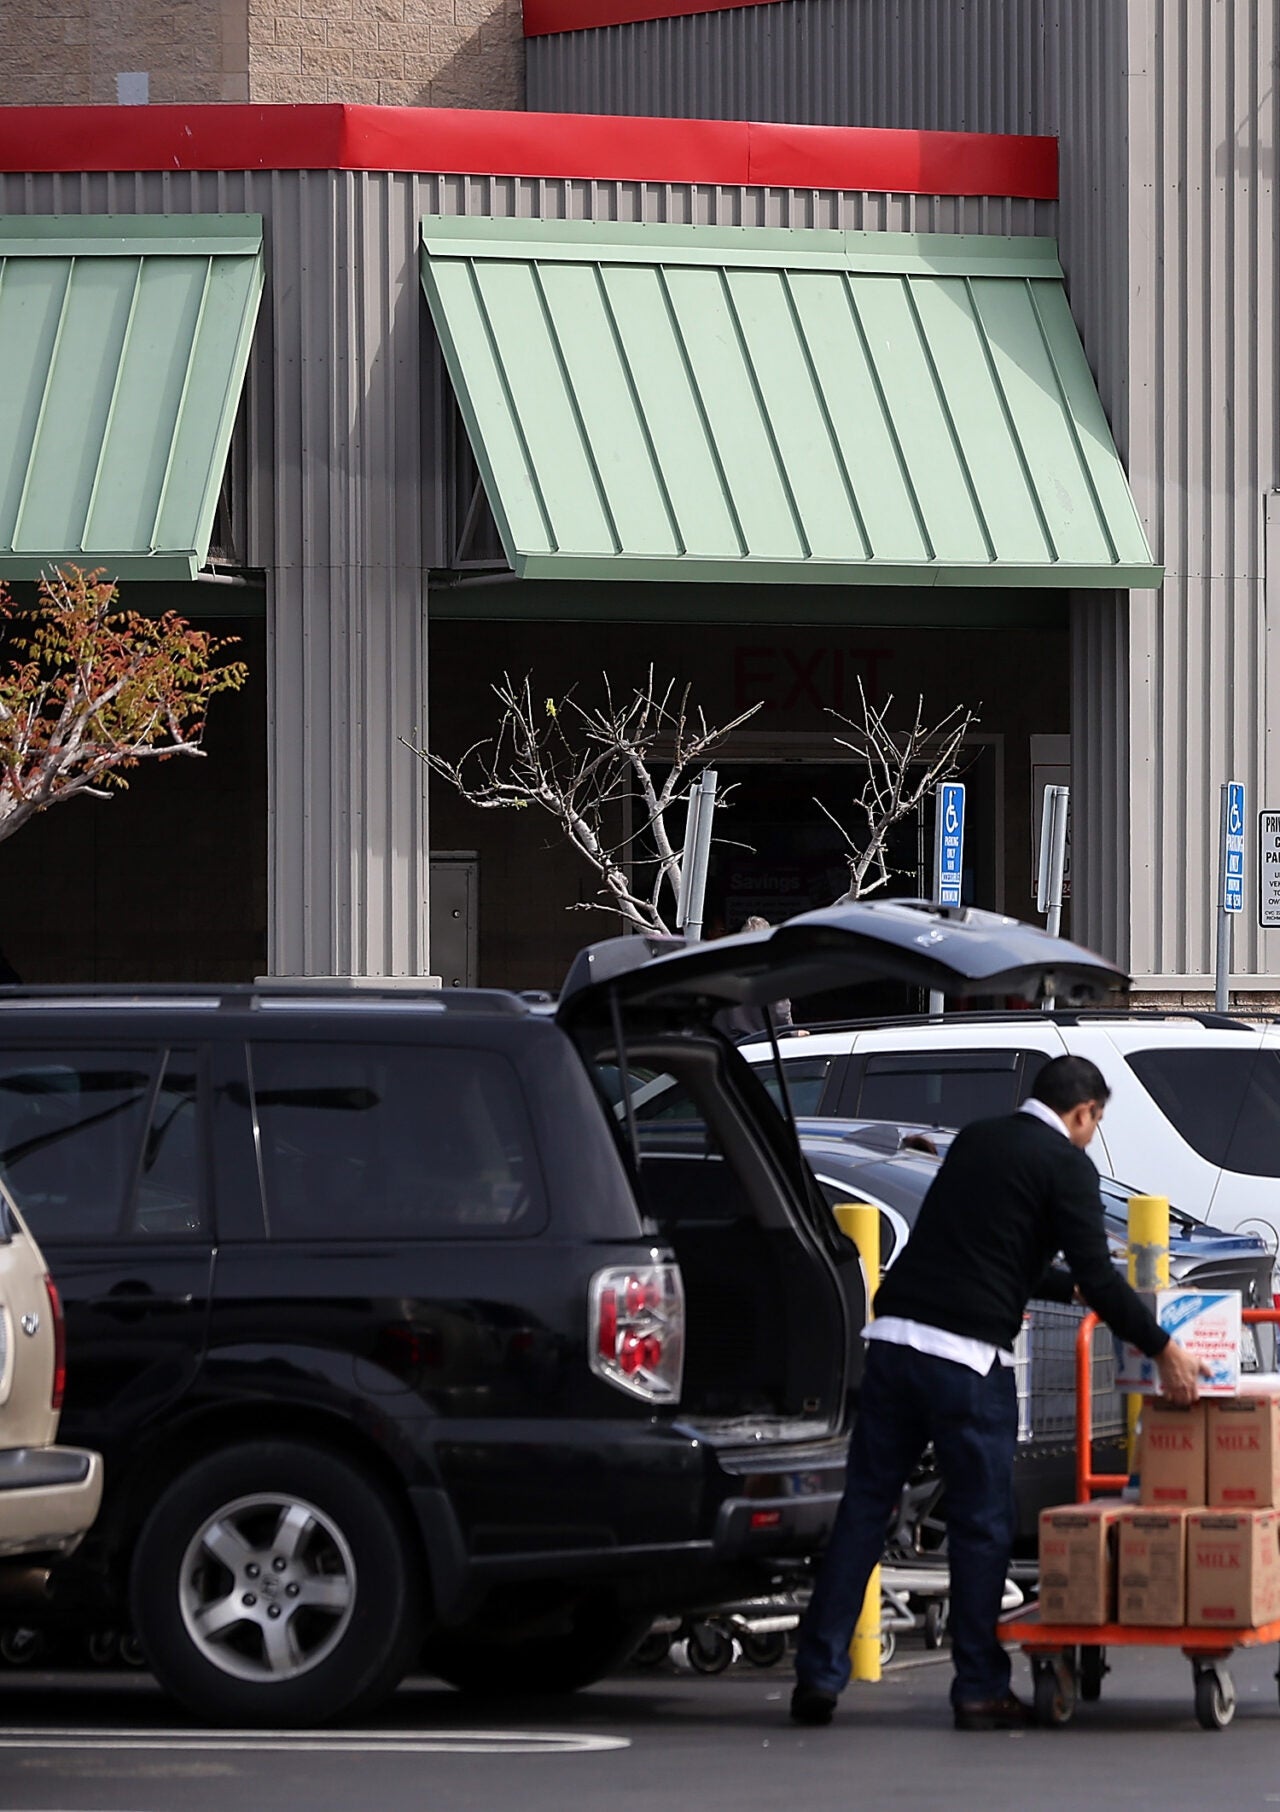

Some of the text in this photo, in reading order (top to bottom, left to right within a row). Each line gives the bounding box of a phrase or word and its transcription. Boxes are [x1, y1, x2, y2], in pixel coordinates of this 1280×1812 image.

[733, 646, 896, 711] EXIT
[1150, 1432, 1193, 1450] MILK
[1216, 1434, 1260, 1450] MILK
[1196, 1553, 1240, 1569] MILK
